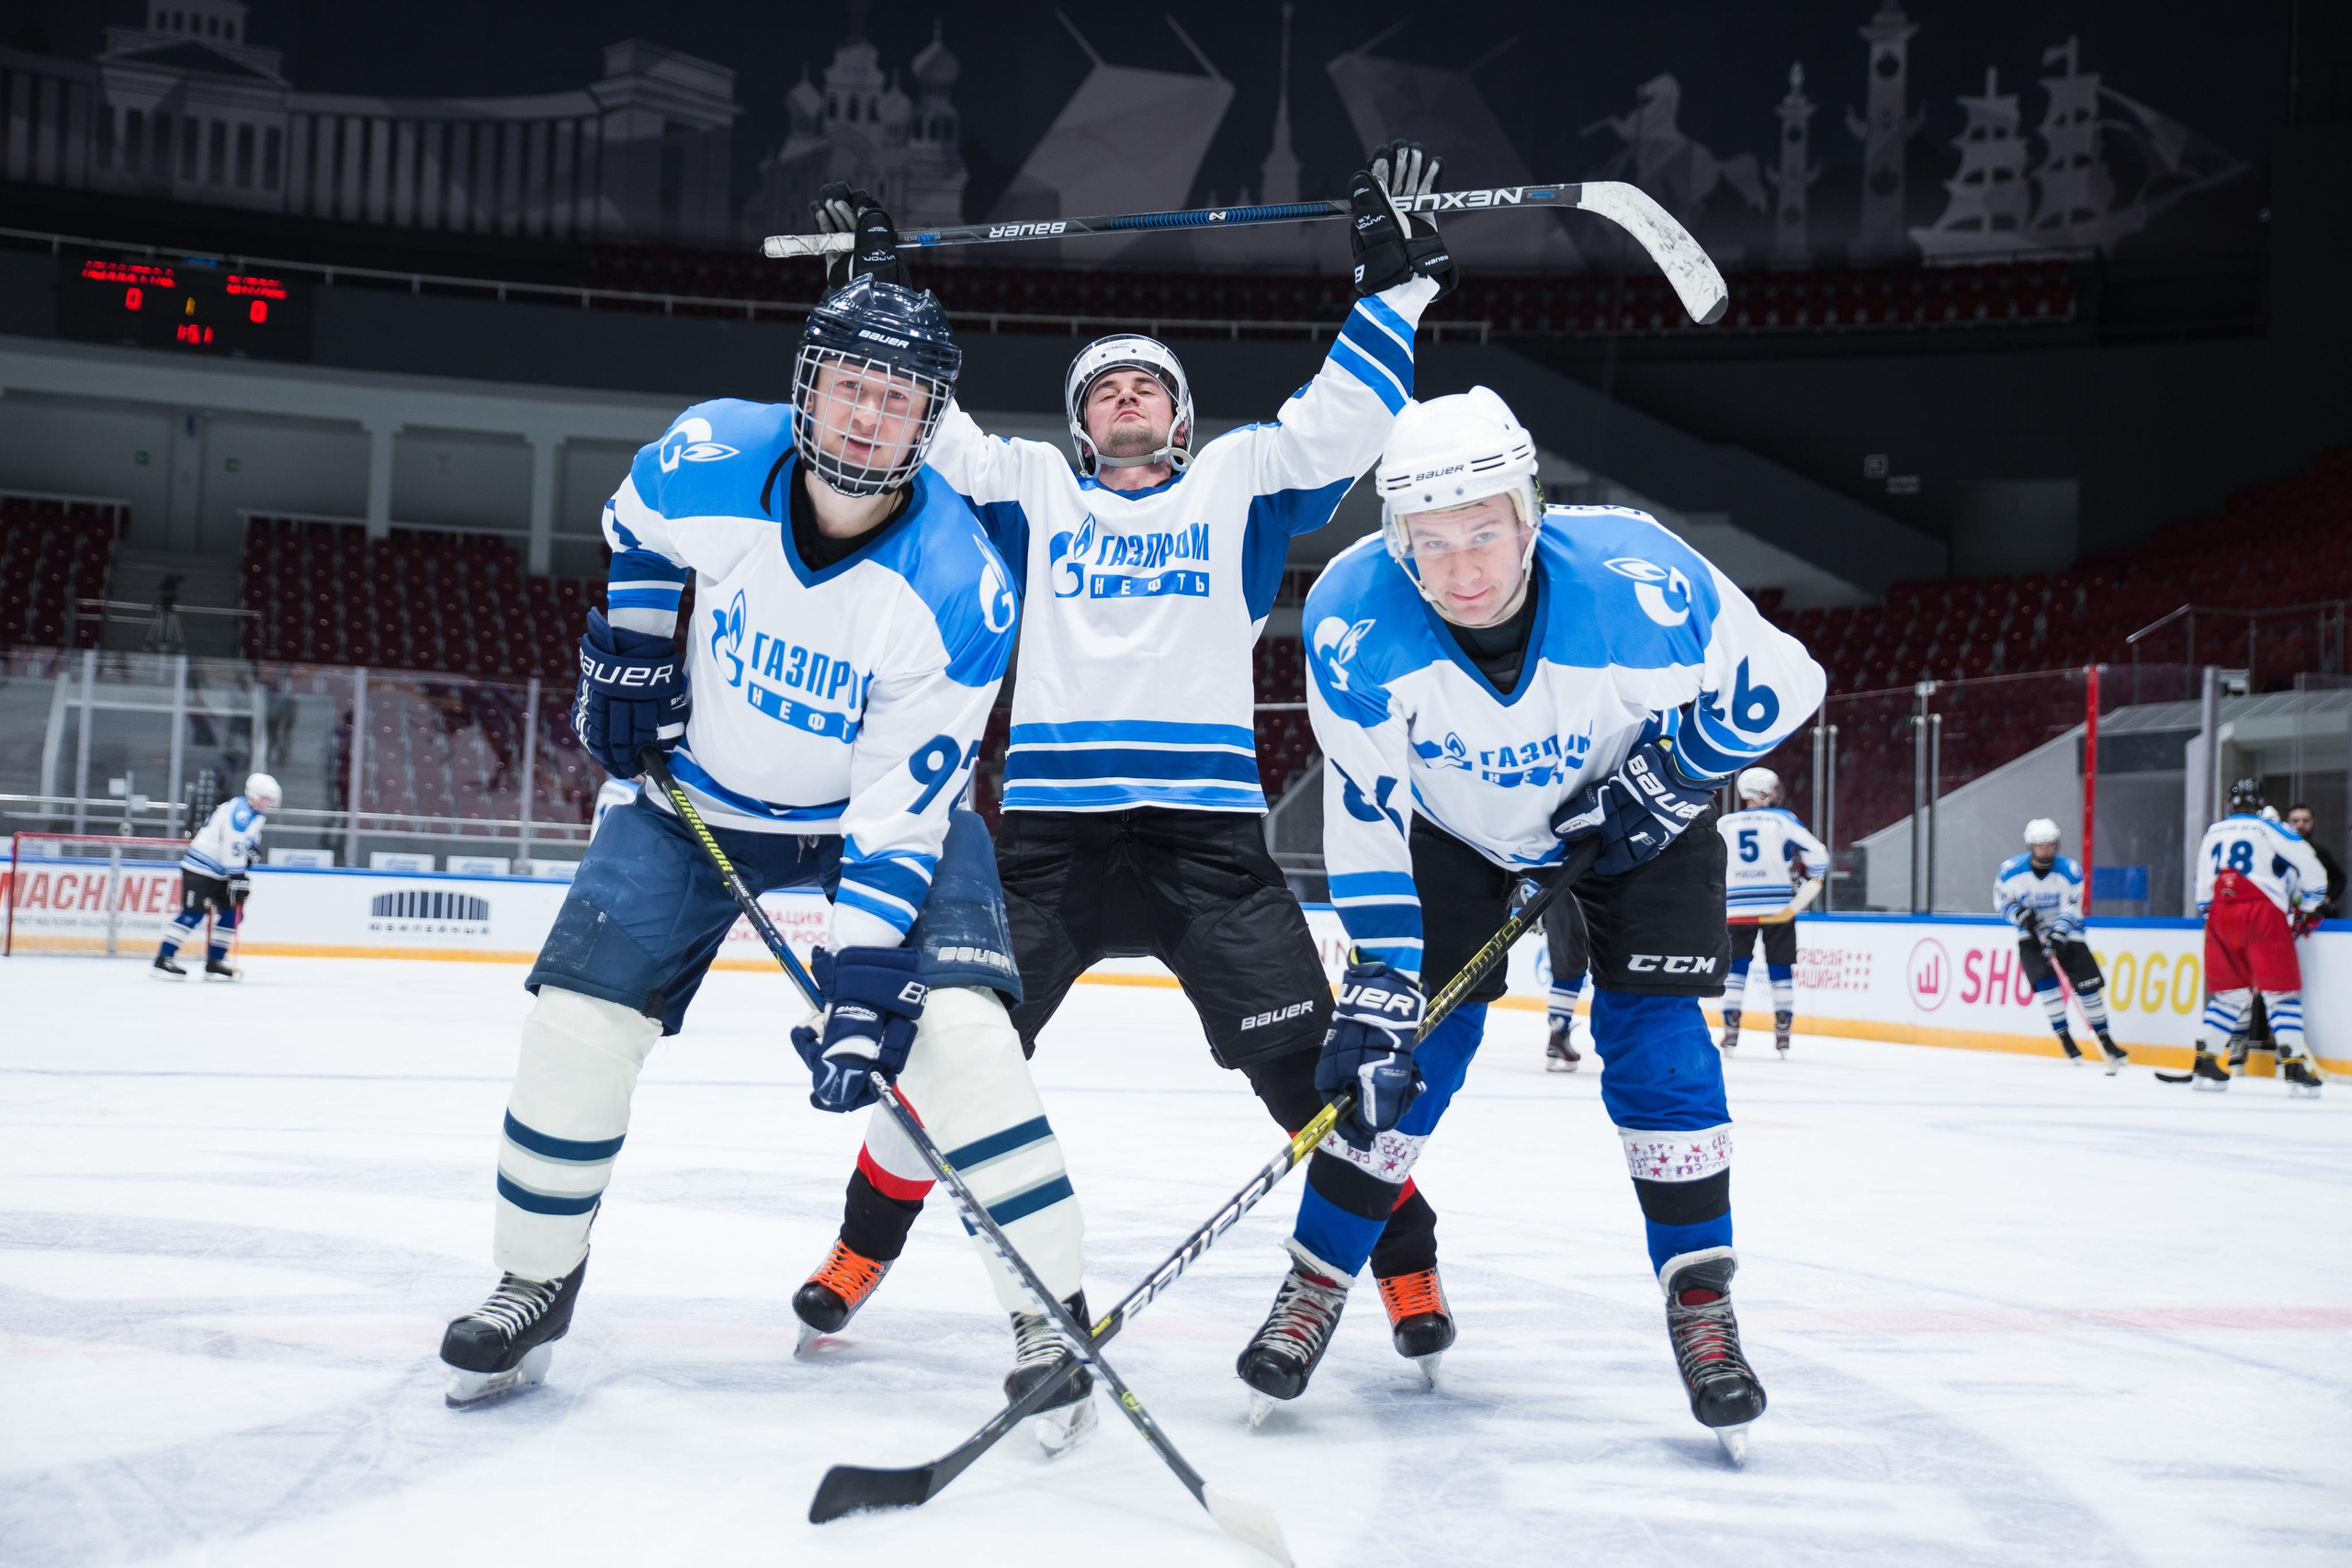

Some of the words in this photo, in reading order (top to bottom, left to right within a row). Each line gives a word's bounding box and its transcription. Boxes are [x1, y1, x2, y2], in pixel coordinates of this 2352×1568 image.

[1392, 187, 1523, 212] NEXUS
[989, 221, 1067, 239] BAUER
[1425, 254, 1449, 266] BAUER
[858, 329, 910, 349] BAUER
[1415, 464, 1464, 482] BAUER
[1095, 522, 1209, 570] ГАЗПРОМ
[1094, 572, 1205, 596] НЕФТЬ
[752, 686, 851, 741] НЕФТ
[671, 789, 734, 874] WARRIOR
[1738, 829, 1759, 863] 5
[2211, 840, 2254, 875] 18
[729, 874, 750, 897] DYNAMO
[1627, 953, 1717, 975] CCM
[1797, 948, 1842, 965] РАСНАЯ
[1339, 983, 1415, 1017] UER
[1240, 999, 1314, 1031] BAUER
[1346, 1145, 1370, 1164] СКА
[1383, 1145, 1408, 1160] СКА
[1123, 1175, 1270, 1320] BAUER
